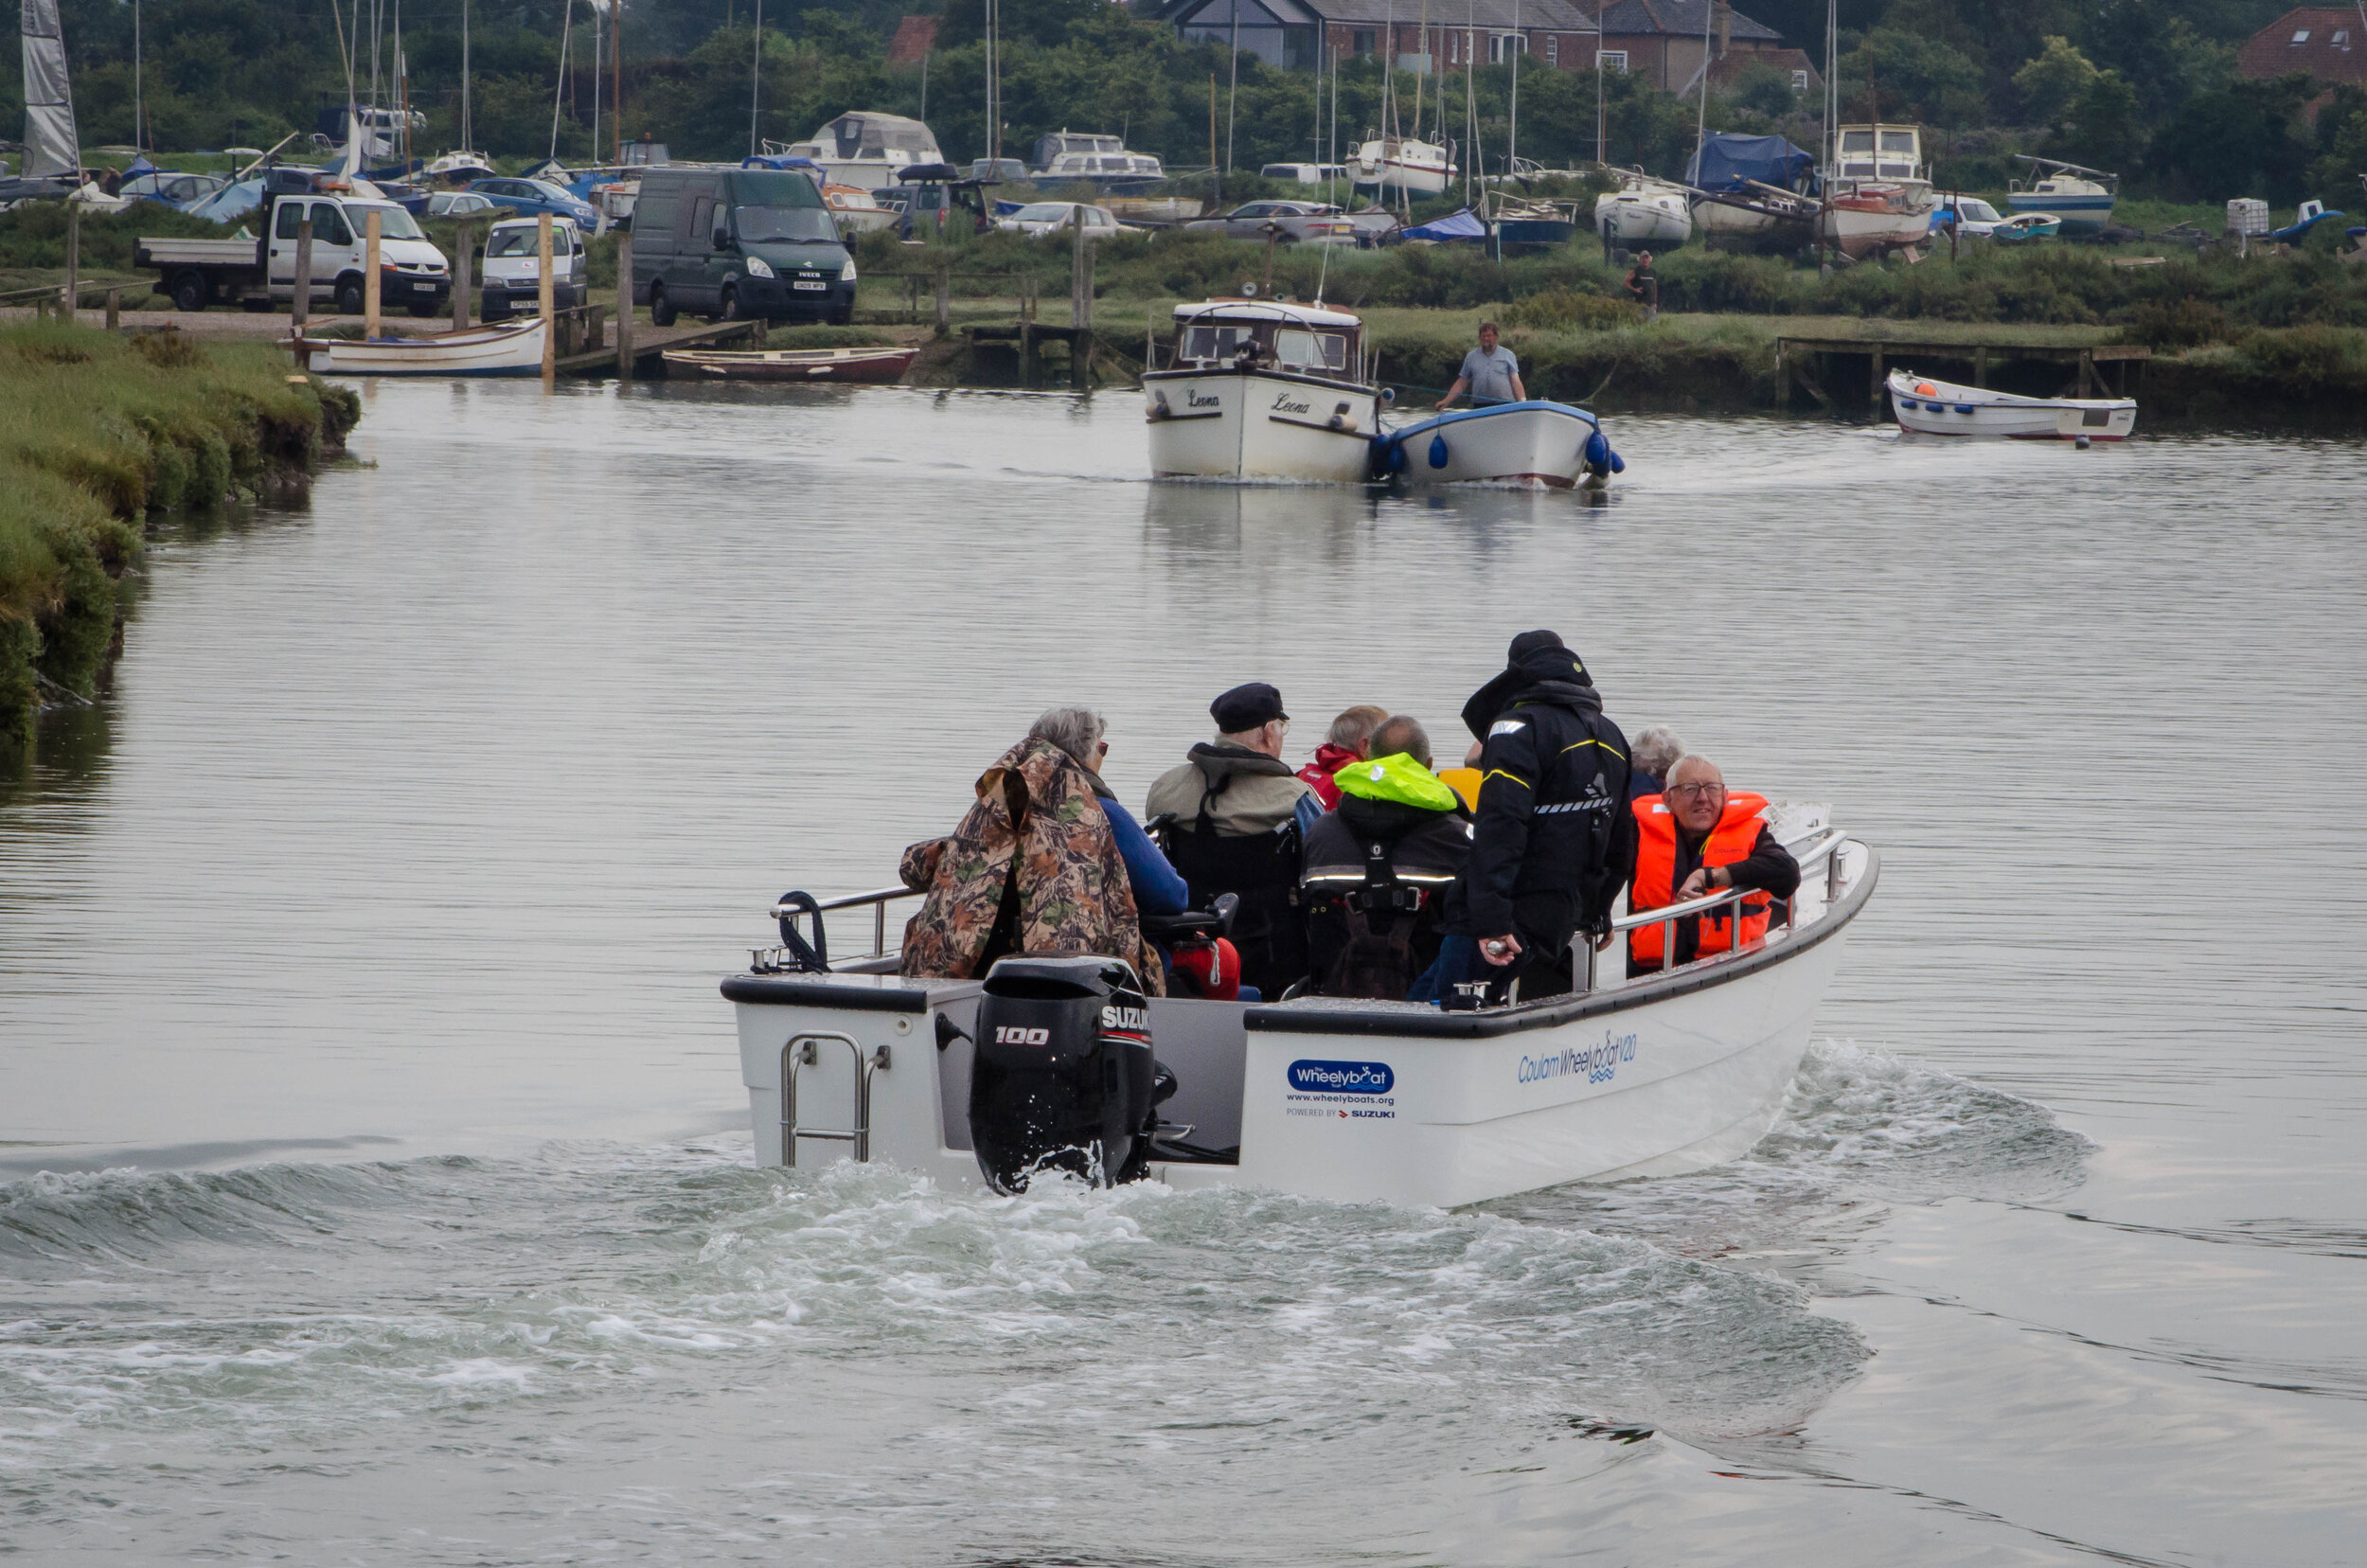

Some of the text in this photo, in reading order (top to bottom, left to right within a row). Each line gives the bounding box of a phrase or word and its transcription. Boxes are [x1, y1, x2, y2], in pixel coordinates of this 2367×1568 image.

[1187, 389, 1219, 407] Leona
[1271, 393, 1310, 414] Leona
[1102, 1006, 1149, 1030] SUZUK
[995, 1025, 1050, 1046] 100
[1518, 1053, 1559, 1084] Coulam
[1619, 1033, 1637, 1062] V20
[1287, 1095, 1395, 1106] www.wheelyboats.org
[1287, 1108, 1395, 1119] POWERED BY SUZUKI
